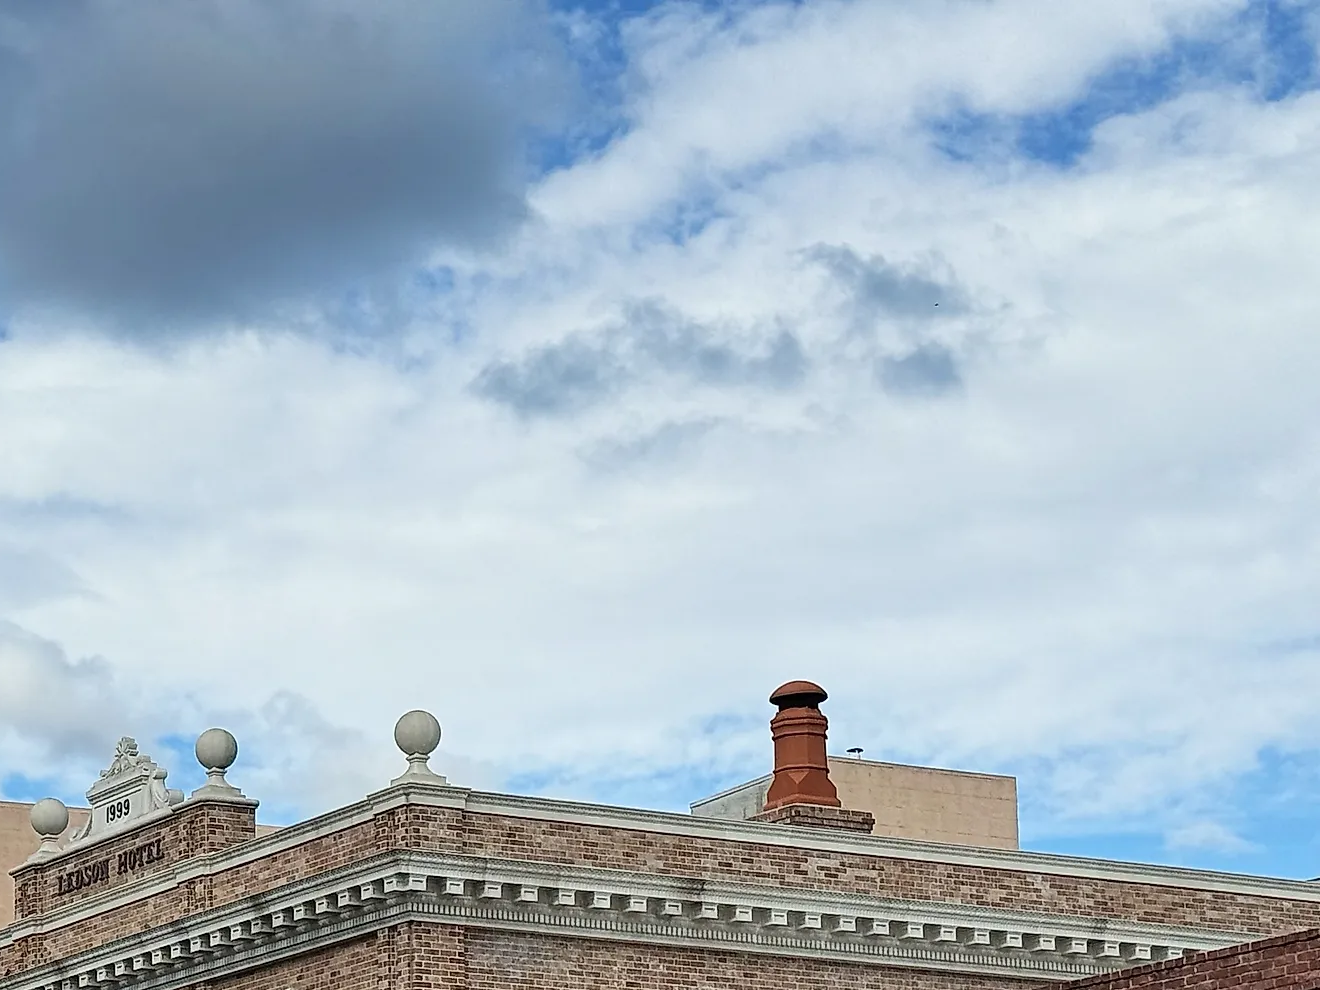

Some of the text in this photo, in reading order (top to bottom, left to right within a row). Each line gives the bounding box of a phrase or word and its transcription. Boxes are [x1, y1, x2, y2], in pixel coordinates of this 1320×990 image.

[106, 798, 131, 824] 1999
[57, 837, 165, 896] LEDSON HOTEL
